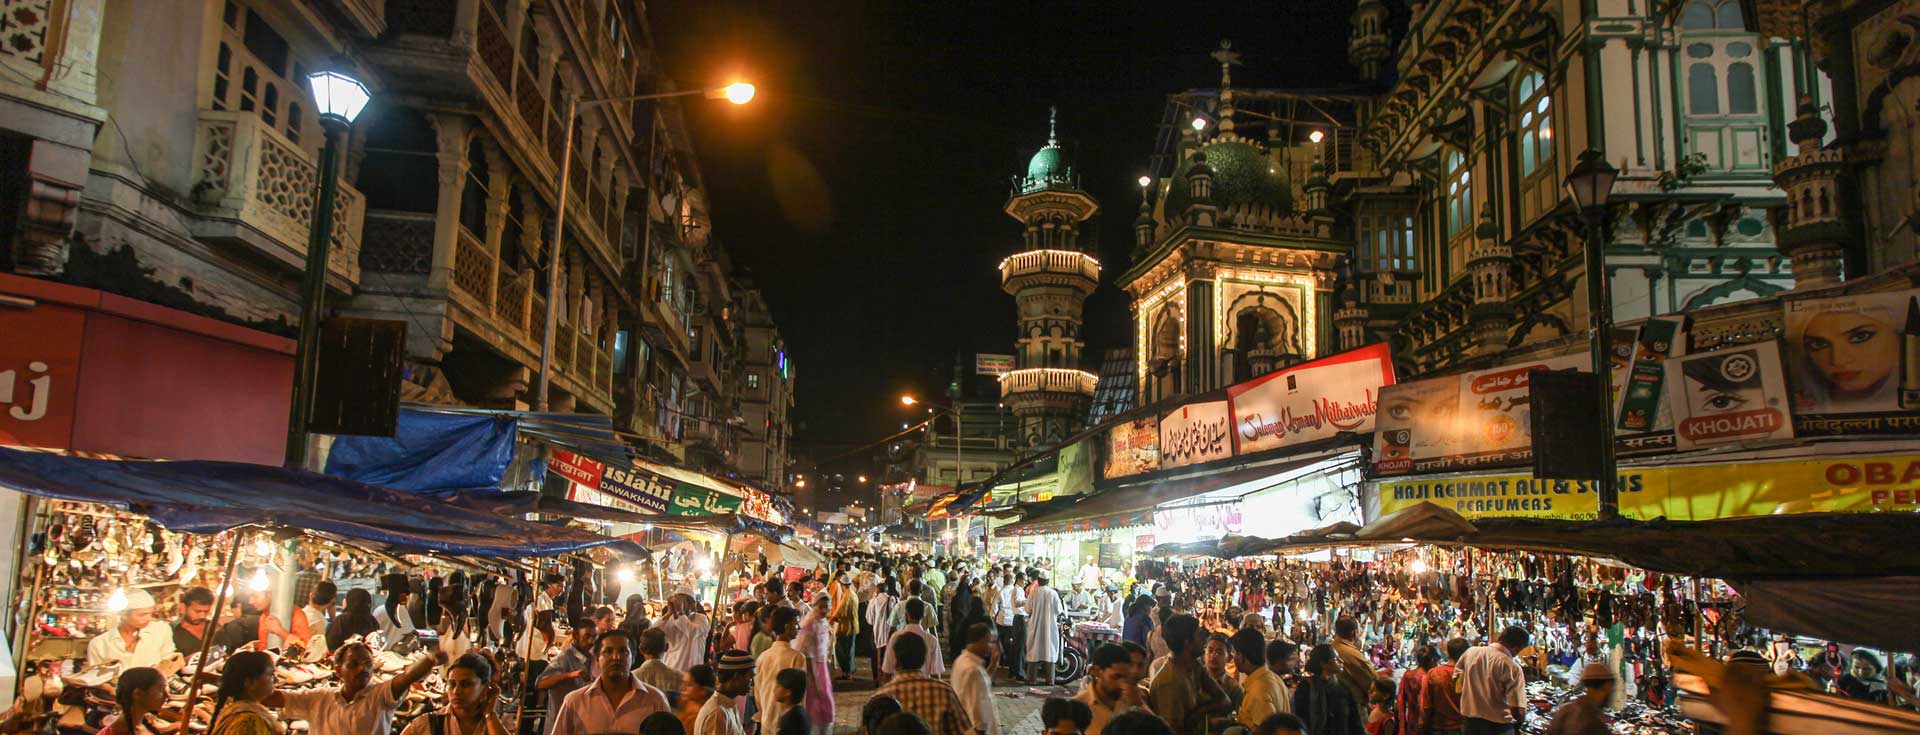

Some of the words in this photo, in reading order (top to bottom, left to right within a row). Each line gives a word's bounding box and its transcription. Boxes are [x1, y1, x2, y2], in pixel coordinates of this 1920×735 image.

[1242, 413, 1286, 441] Suleman
[1281, 405, 1317, 433] Usman
[1312, 388, 1378, 431] Mithaiwala
[1689, 413, 1774, 436] KHOJATI
[600, 481, 666, 512] DAWAKHANA
[1393, 484, 1429, 499] HAJI
[1434, 480, 1509, 498] REHMAT
[1516, 478, 1547, 496] ALI
[1457, 497, 1552, 512] PERFUMERS
